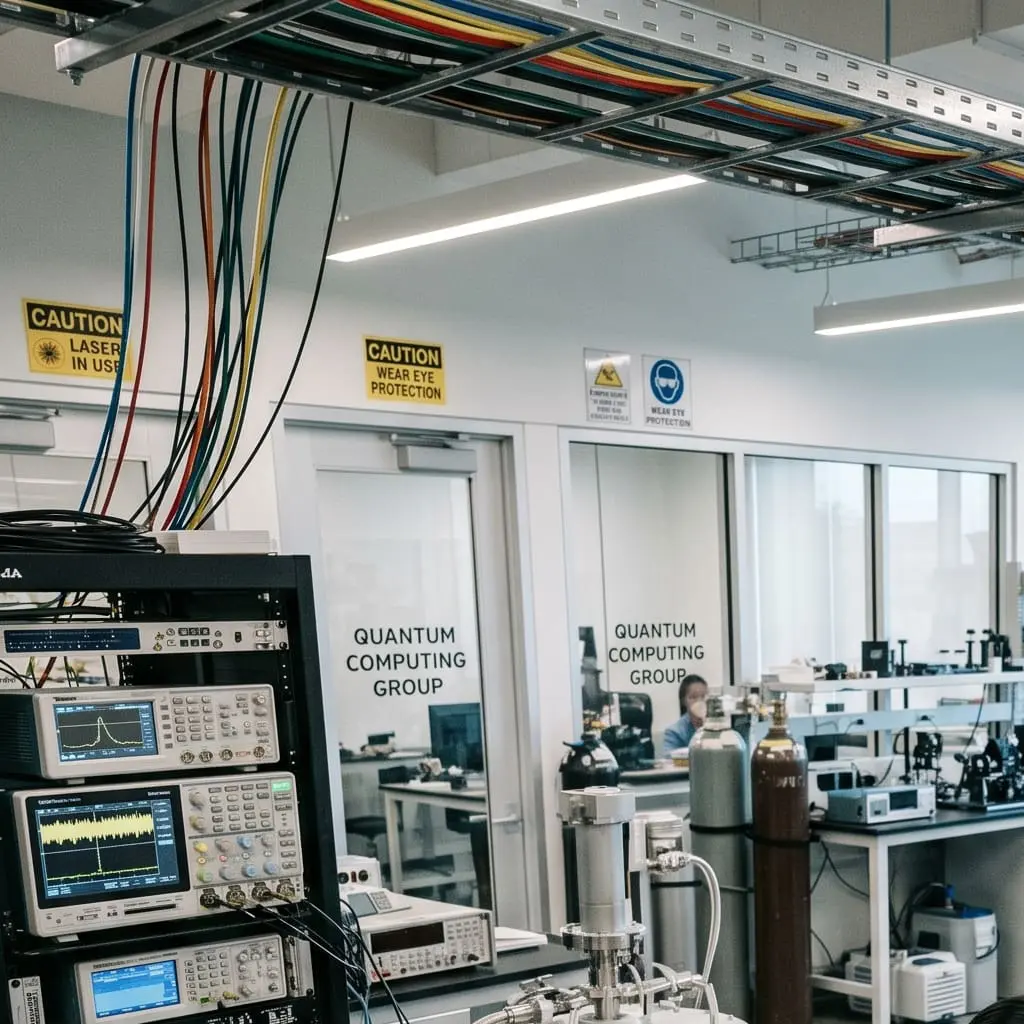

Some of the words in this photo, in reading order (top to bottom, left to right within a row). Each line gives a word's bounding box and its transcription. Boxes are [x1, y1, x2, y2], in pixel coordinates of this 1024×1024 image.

[31, 307, 123, 335] CAUTION
[69, 338, 120, 356] LASER
[368, 343, 439, 366] CAUTION
[72, 356, 87, 371] IN
[376, 366, 410, 381] WEAR
[413, 369, 435, 384] EYE
[371, 381, 442, 400] PROTECTION
[354, 626, 455, 645] QUANTUM
[615, 622, 696, 639] QUANTUM
[346, 652, 466, 672] COMPUTING
[608, 645, 704, 663] COMPUTING
[630, 668, 687, 685] GROUP
[373, 678, 443, 697] GROUP
